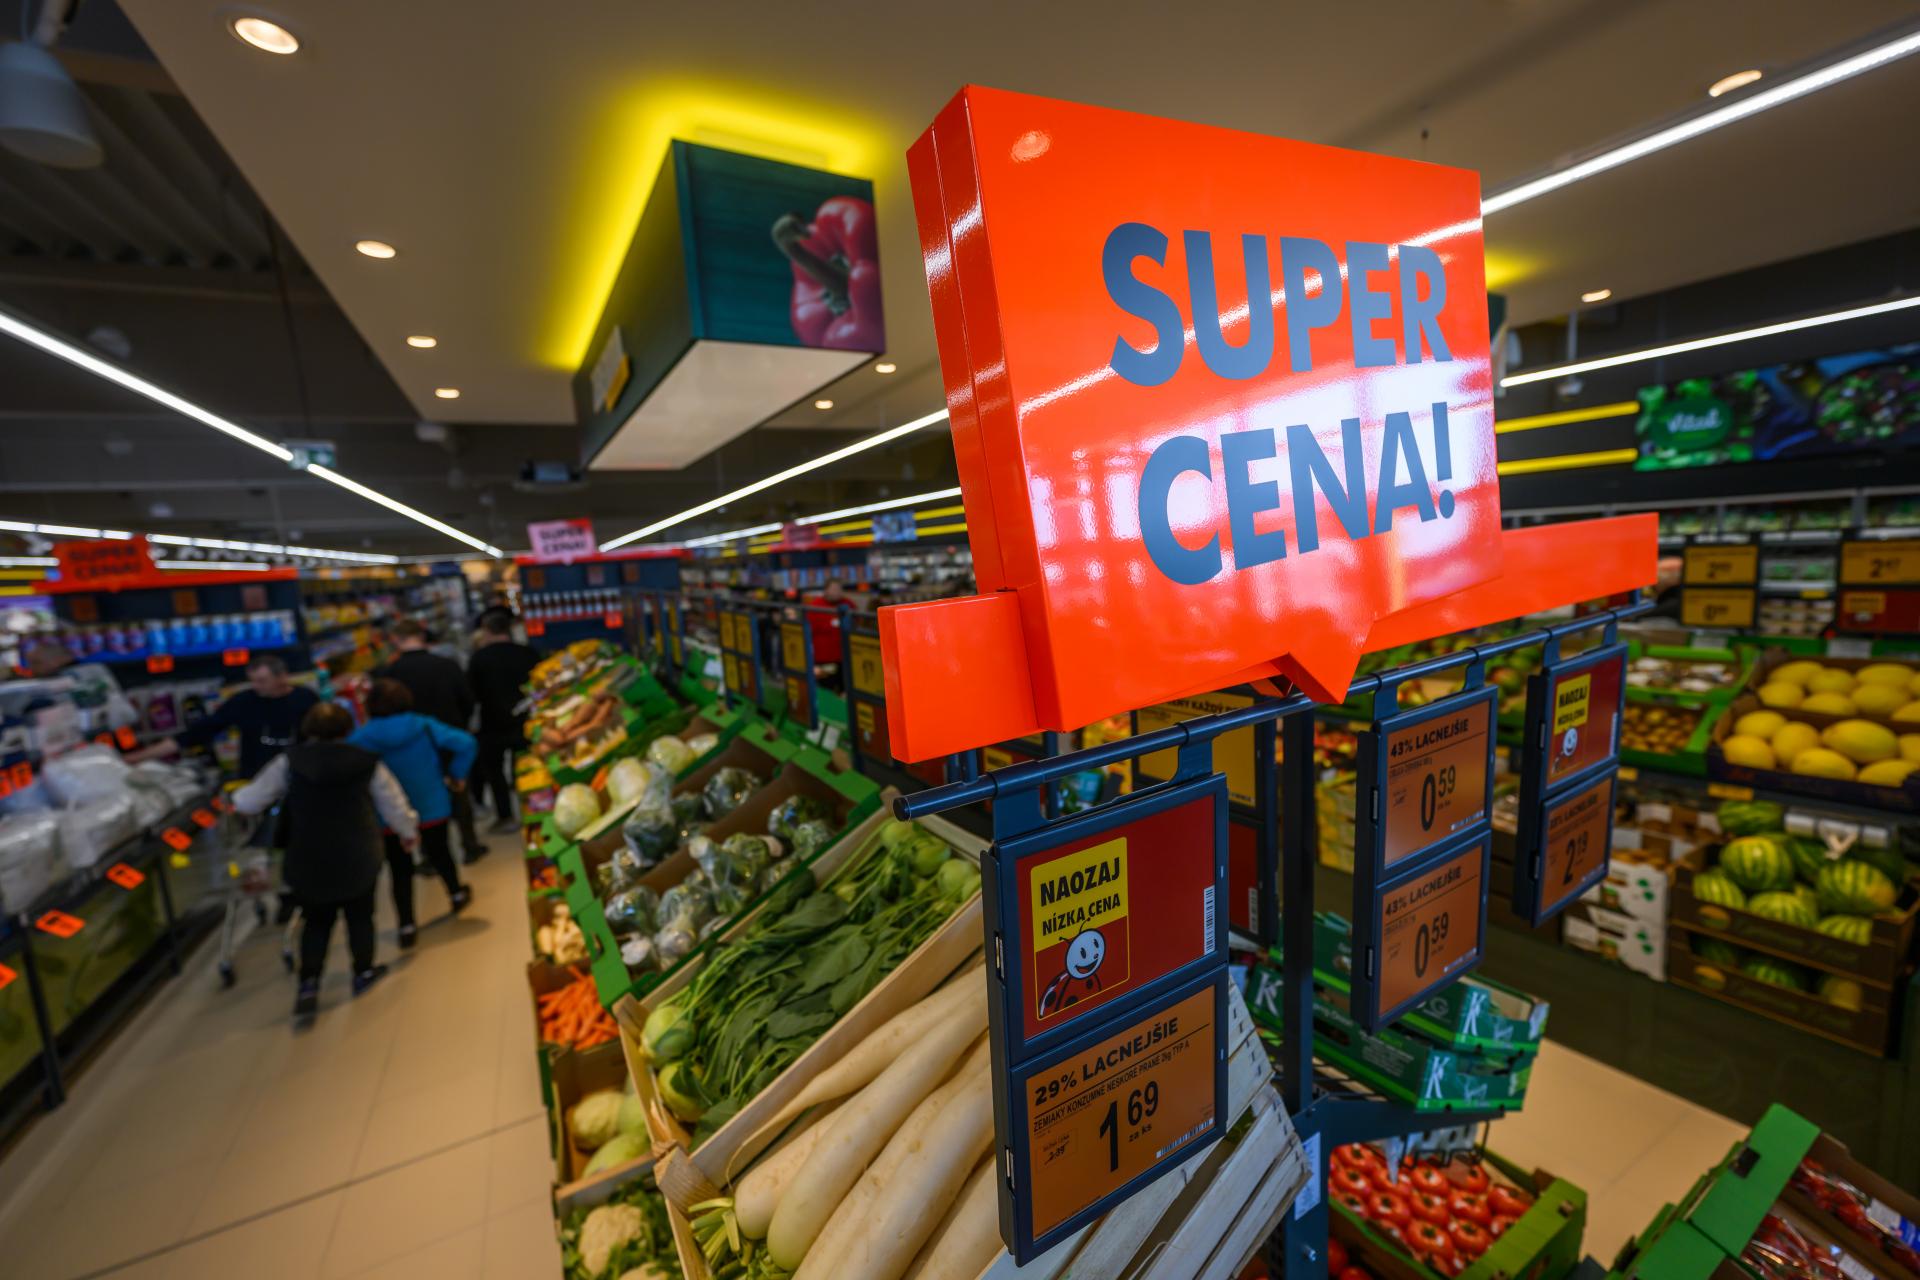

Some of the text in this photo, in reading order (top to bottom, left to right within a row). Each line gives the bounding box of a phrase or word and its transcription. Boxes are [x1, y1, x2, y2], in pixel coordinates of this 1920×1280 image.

[1102, 222, 1453, 387] SUPER
[1138, 402, 1455, 585] CENA!
[1390, 718, 1469, 757] 43% LACNEJŠIE
[1040, 857, 1120, 907] NAOZAJ
[1042, 893, 1120, 936] NÍZKA CENA
[1035, 1016, 1178, 1106] 29% LACNEJŠIE
[1033, 1107, 1065, 1132] ZEMIAKY
